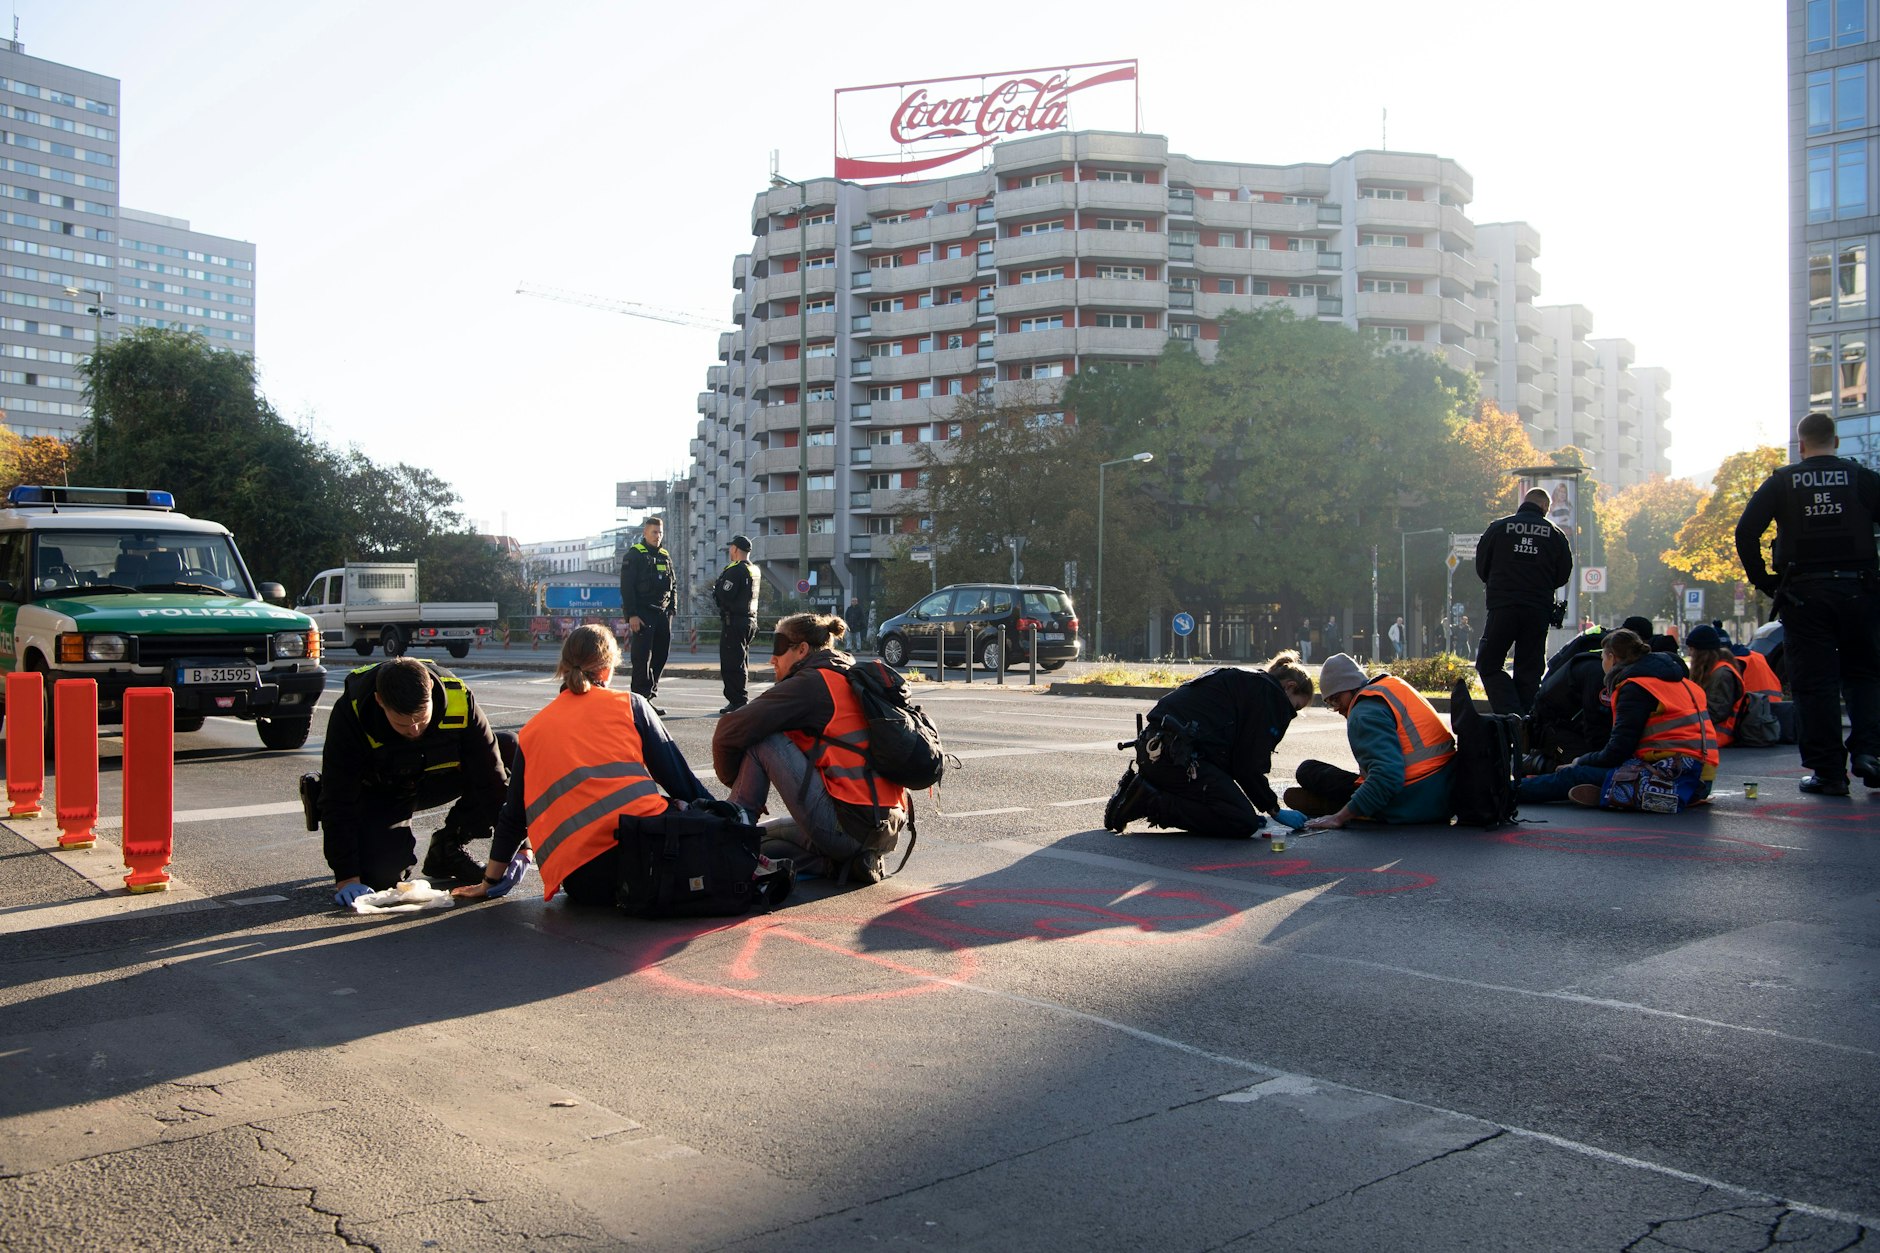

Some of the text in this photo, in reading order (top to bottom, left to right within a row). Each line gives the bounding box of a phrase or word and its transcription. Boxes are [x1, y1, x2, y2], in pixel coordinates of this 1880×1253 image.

[890, 74, 1068, 144] Coca-Cola
[1792, 470, 1849, 489] POLIZEI
[1813, 492, 1831, 504] BE
[1804, 503, 1843, 516] 31225
[1505, 522, 1550, 538] POLIZEI
[1521, 537, 1534, 546] BE
[1513, 544, 1539, 554] 31215
[1588, 573, 1599, 581] 30
[580, 588, 591, 600] U
[1690, 593, 1698, 602] P
[138, 608, 259, 617] POLIZEI
[193, 669, 251, 682] B 31595
